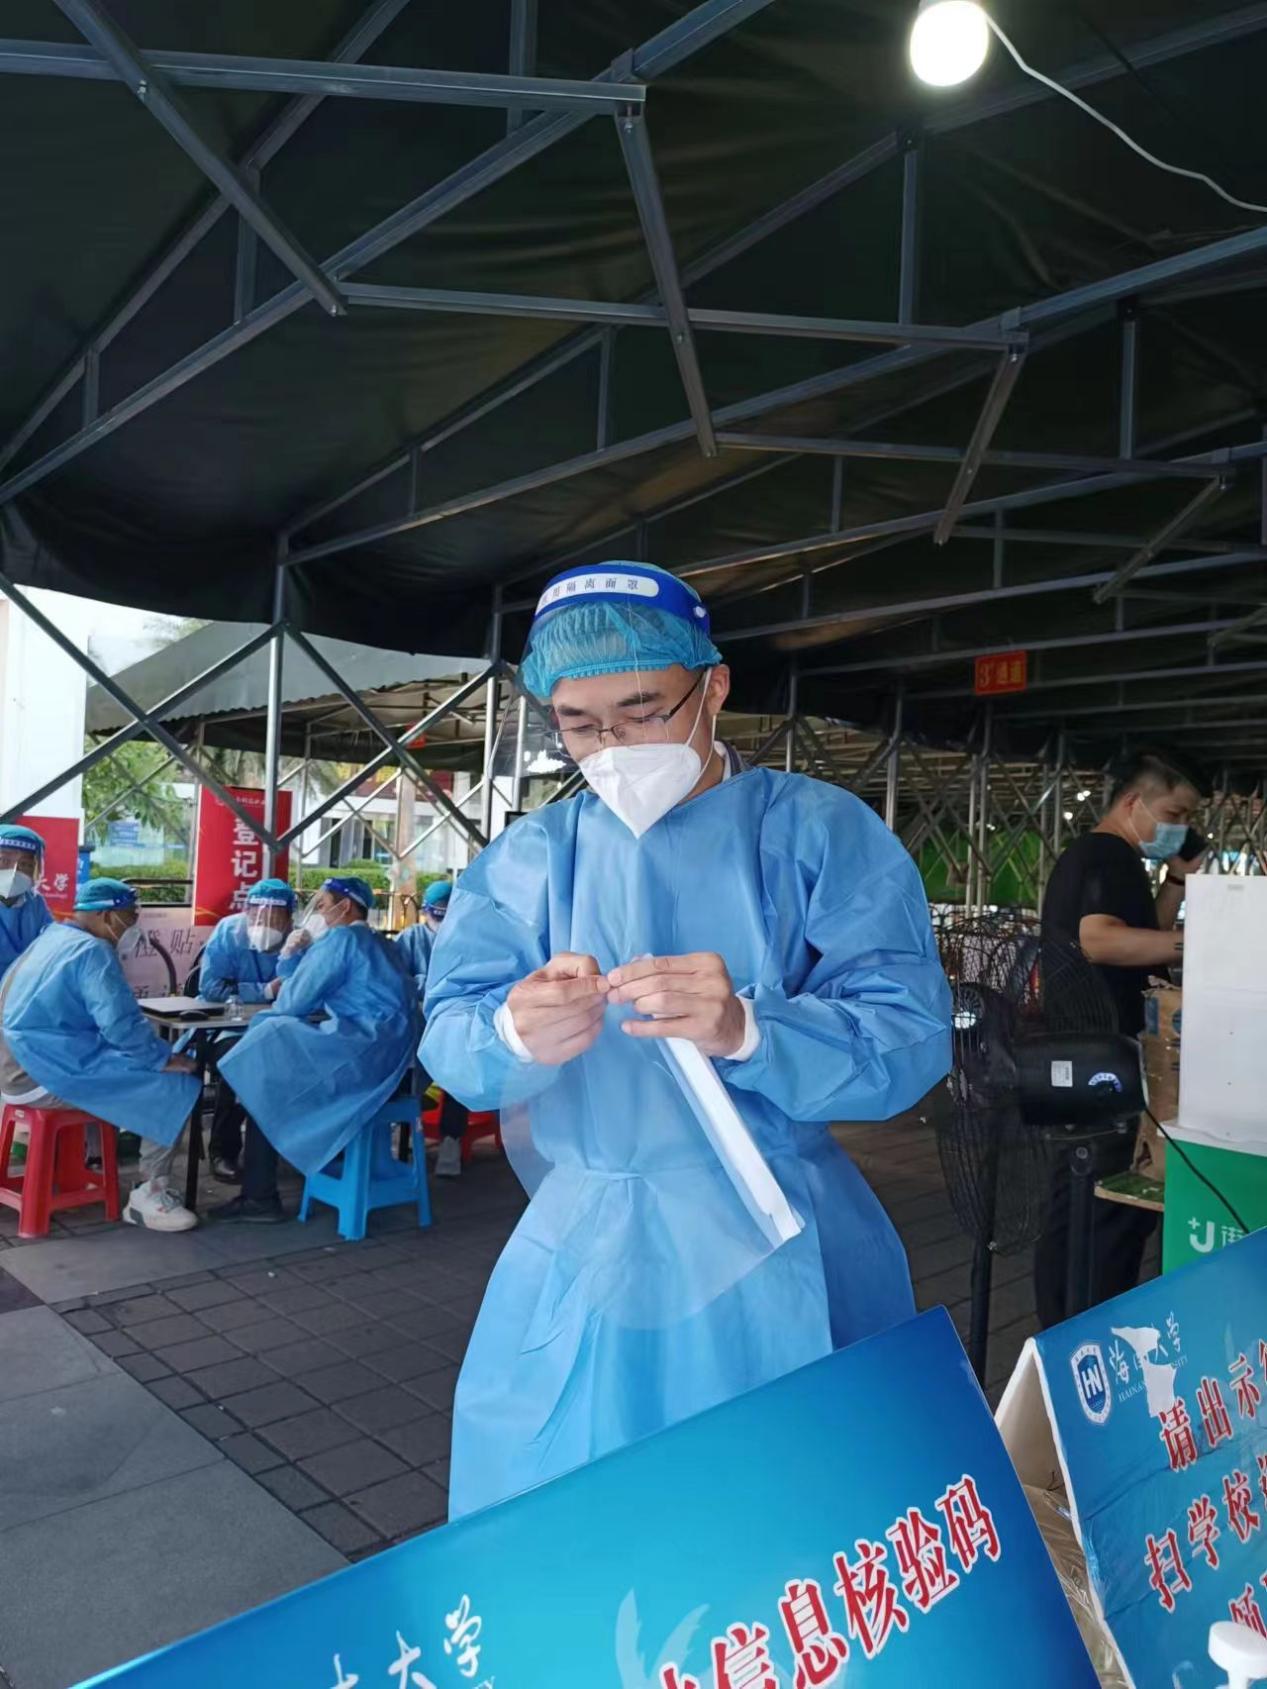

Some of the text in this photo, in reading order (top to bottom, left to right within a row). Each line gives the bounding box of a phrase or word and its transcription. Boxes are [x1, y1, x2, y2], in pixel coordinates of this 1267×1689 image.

[330, 1593, 482, 1689] 大学
[659, 1472, 1003, 1689] 信息核验码
